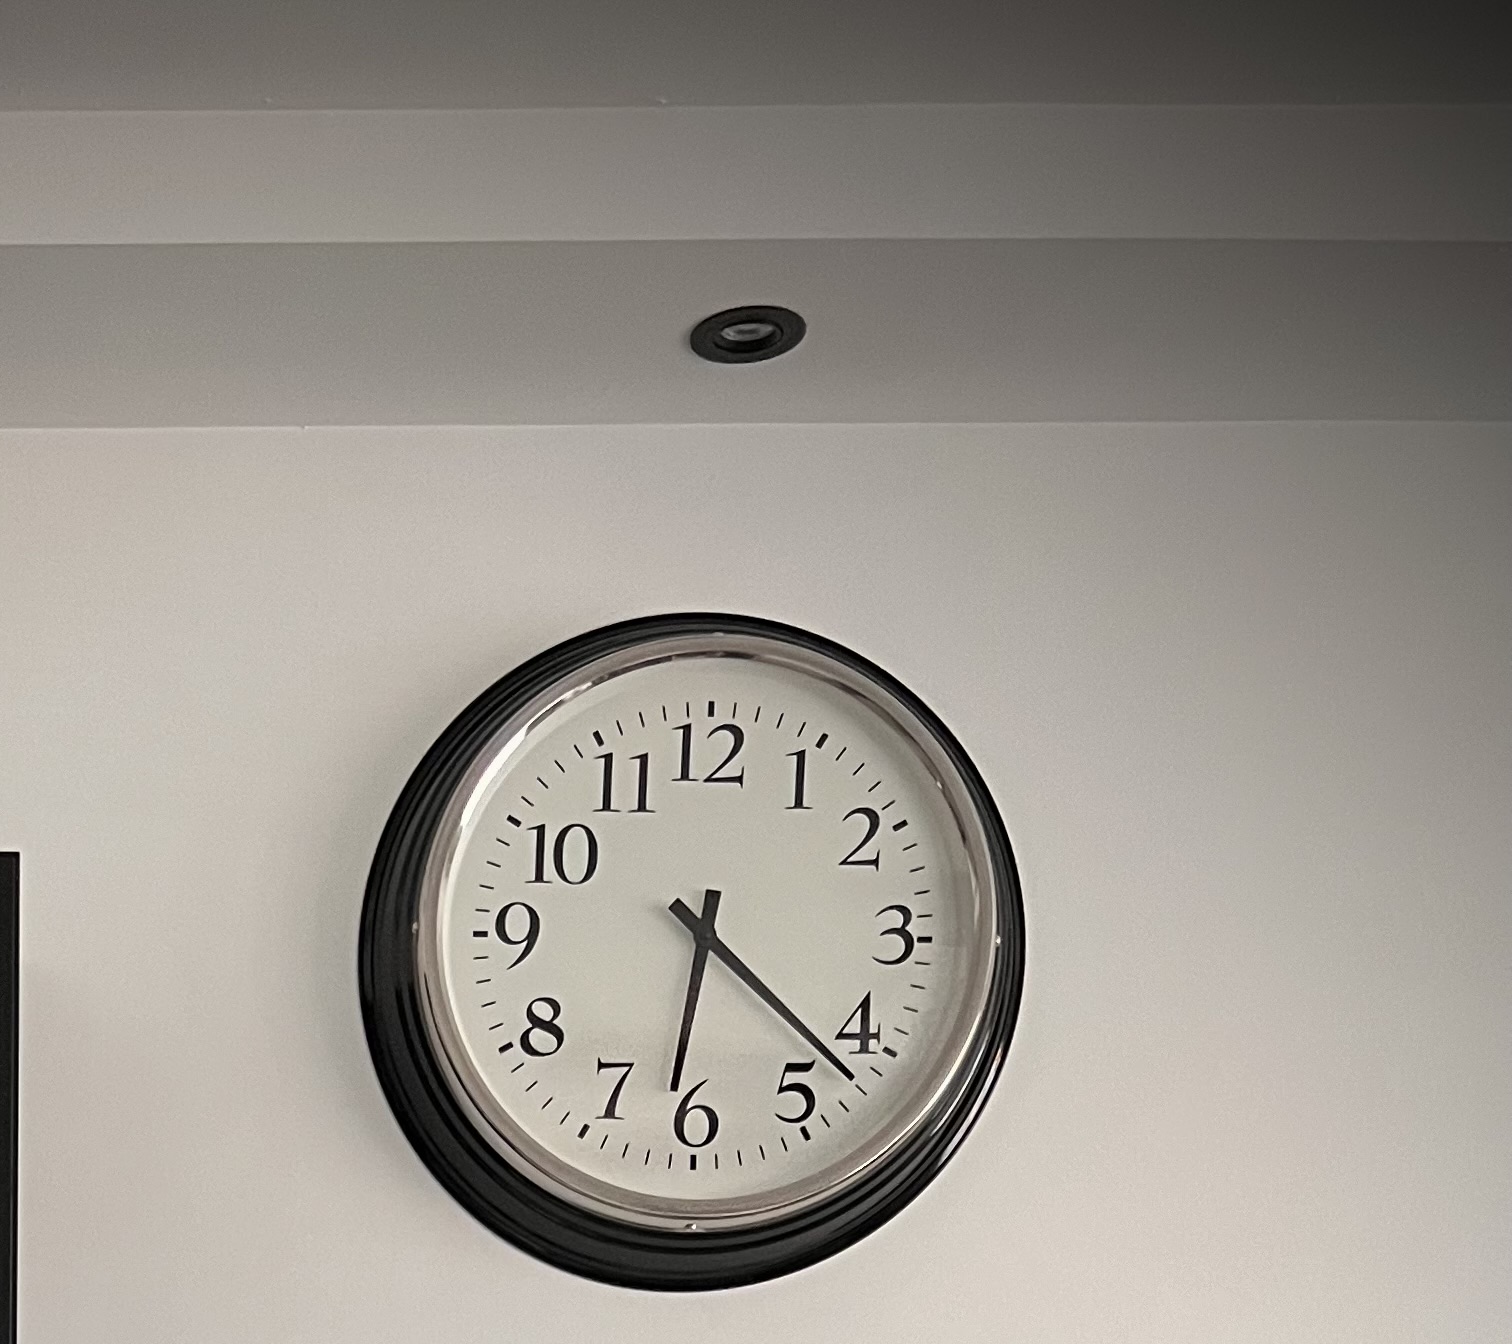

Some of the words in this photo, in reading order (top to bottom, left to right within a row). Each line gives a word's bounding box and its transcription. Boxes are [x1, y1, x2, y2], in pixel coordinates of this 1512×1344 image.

[593, 751, 656, 814] 11
[670, 722, 745, 788] 12
[785, 748, 814, 810] 1
[525, 822, 599, 885] 10
[838, 806, 882, 872] 2
[494, 901, 541, 970] 9
[871, 903, 916, 966] 3
[518, 996, 565, 1057] 8
[834, 990, 882, 1055] 4
[596, 1057, 635, 1121] 7
[673, 1077, 719, 1149] 6
[774, 1058, 817, 1124] 5
